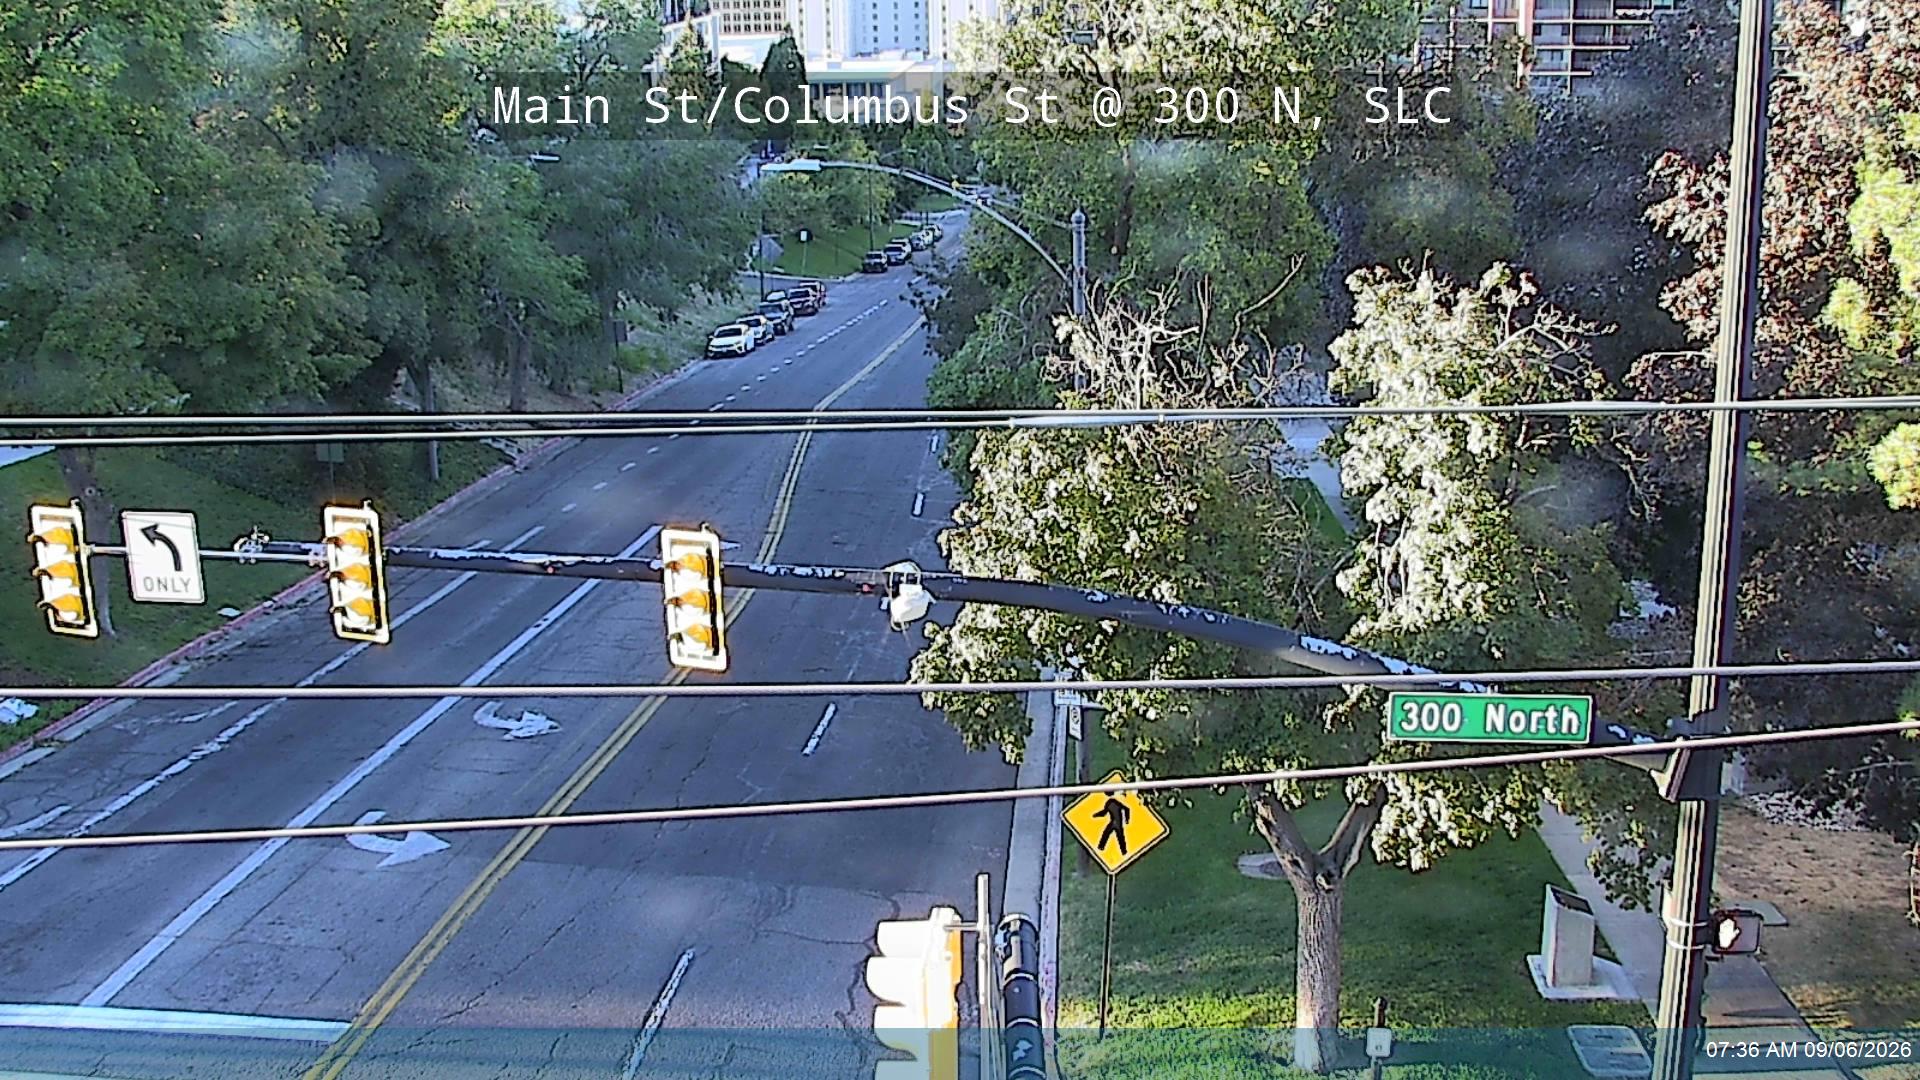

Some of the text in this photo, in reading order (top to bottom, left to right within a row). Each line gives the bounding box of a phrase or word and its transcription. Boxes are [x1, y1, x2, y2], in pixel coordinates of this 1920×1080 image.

[143, 576, 191, 593] ONLY
[1400, 701, 1579, 734] 300 North
